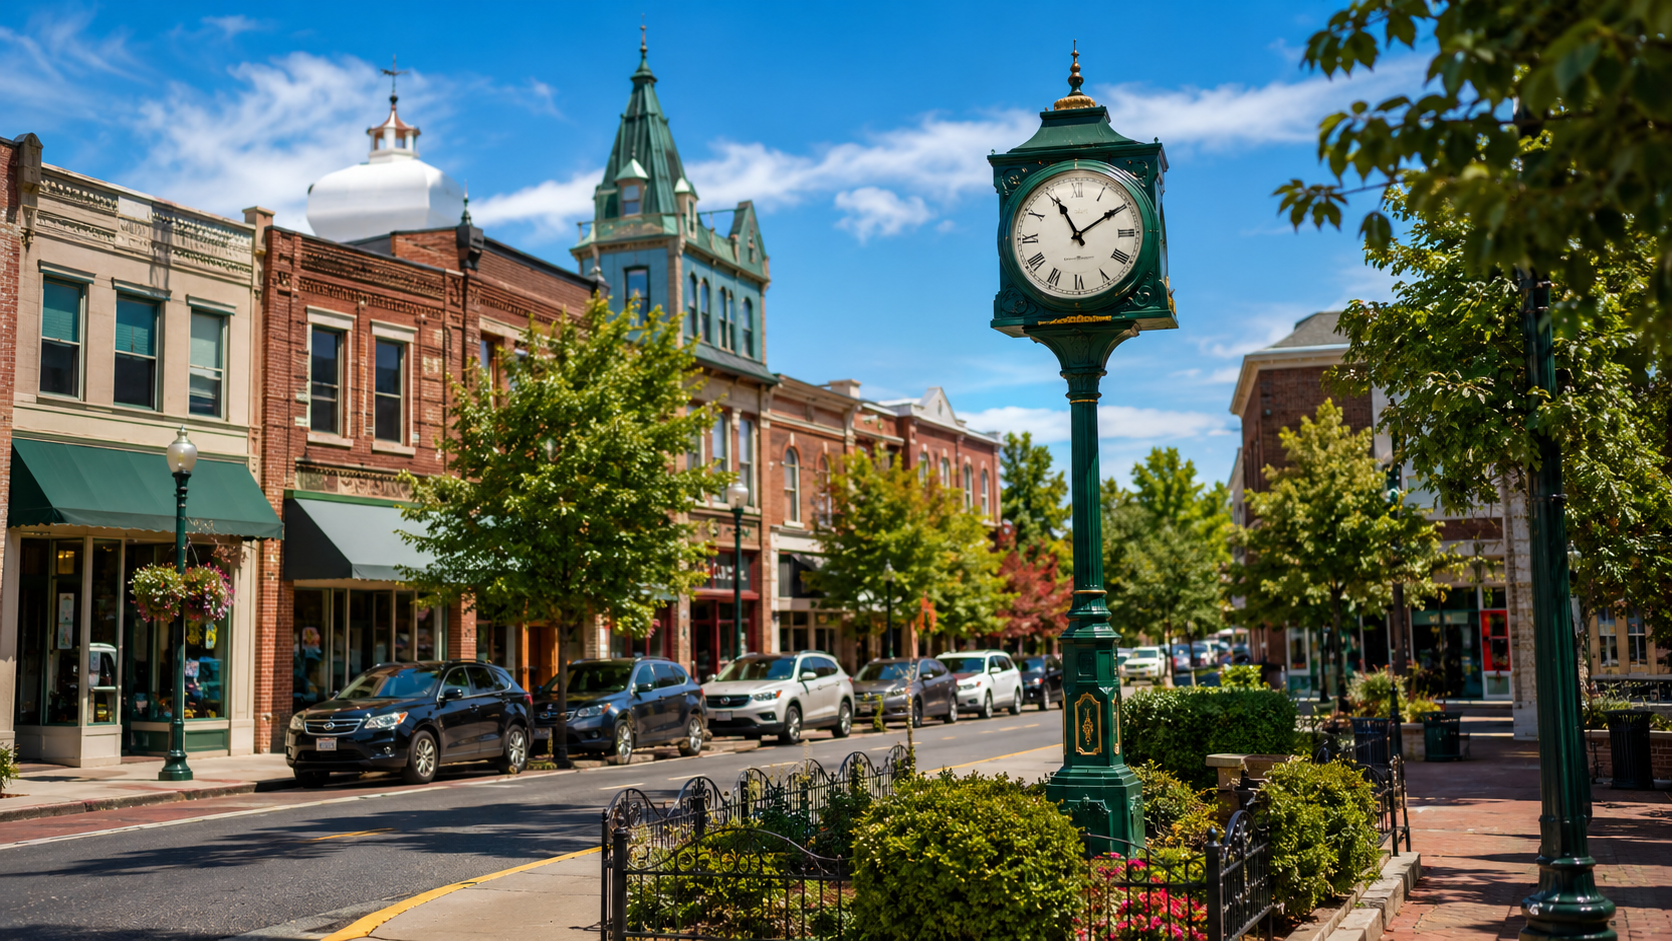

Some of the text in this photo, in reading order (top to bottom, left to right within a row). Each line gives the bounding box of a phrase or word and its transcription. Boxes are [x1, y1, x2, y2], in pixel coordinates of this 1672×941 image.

[1071, 183, 1083, 198] XII
[1028, 210, 1045, 222] X
[1022, 233, 1038, 243] IX
[1118, 229, 1134, 238] III
[1027, 252, 1045, 271] VIII
[1047, 268, 1061, 286] VII
[1075, 274, 1084, 290] VI
[1099, 268, 1110, 283] V
